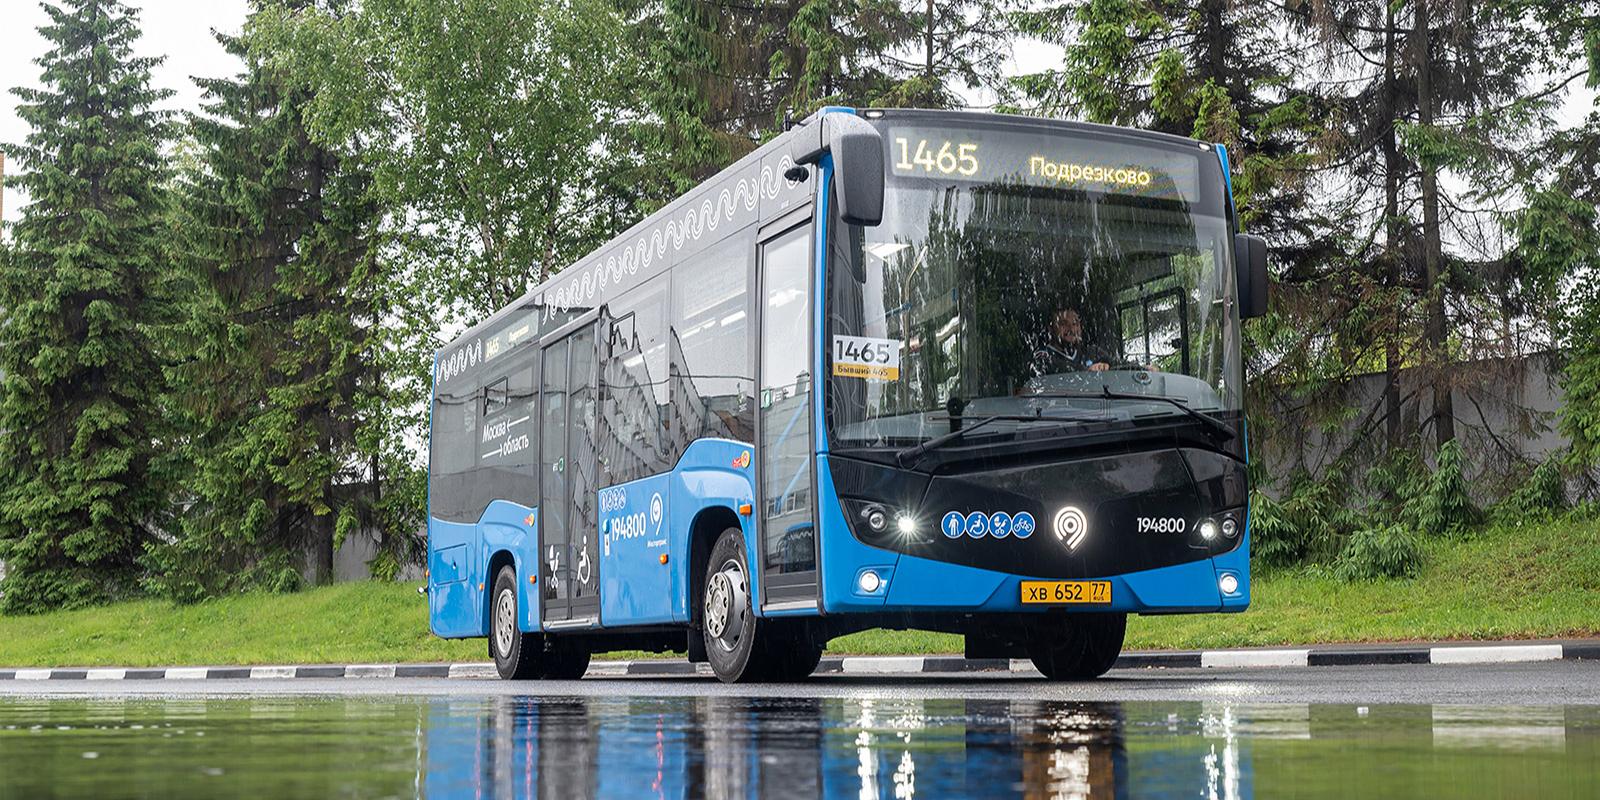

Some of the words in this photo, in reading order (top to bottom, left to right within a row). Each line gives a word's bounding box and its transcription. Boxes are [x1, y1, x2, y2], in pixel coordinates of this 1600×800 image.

[895, 137, 979, 177] 1465
[1030, 155, 1151, 186] Подрезково
[836, 340, 890, 364] 1465
[838, 365, 869, 375] Бывший
[482, 421, 507, 443] Москва
[503, 434, 529, 456] область
[611, 512, 646, 542] 194800
[1137, 517, 1186, 533] 194800
[1054, 584, 1083, 600] 652
[1092, 583, 1106, 596] 77
